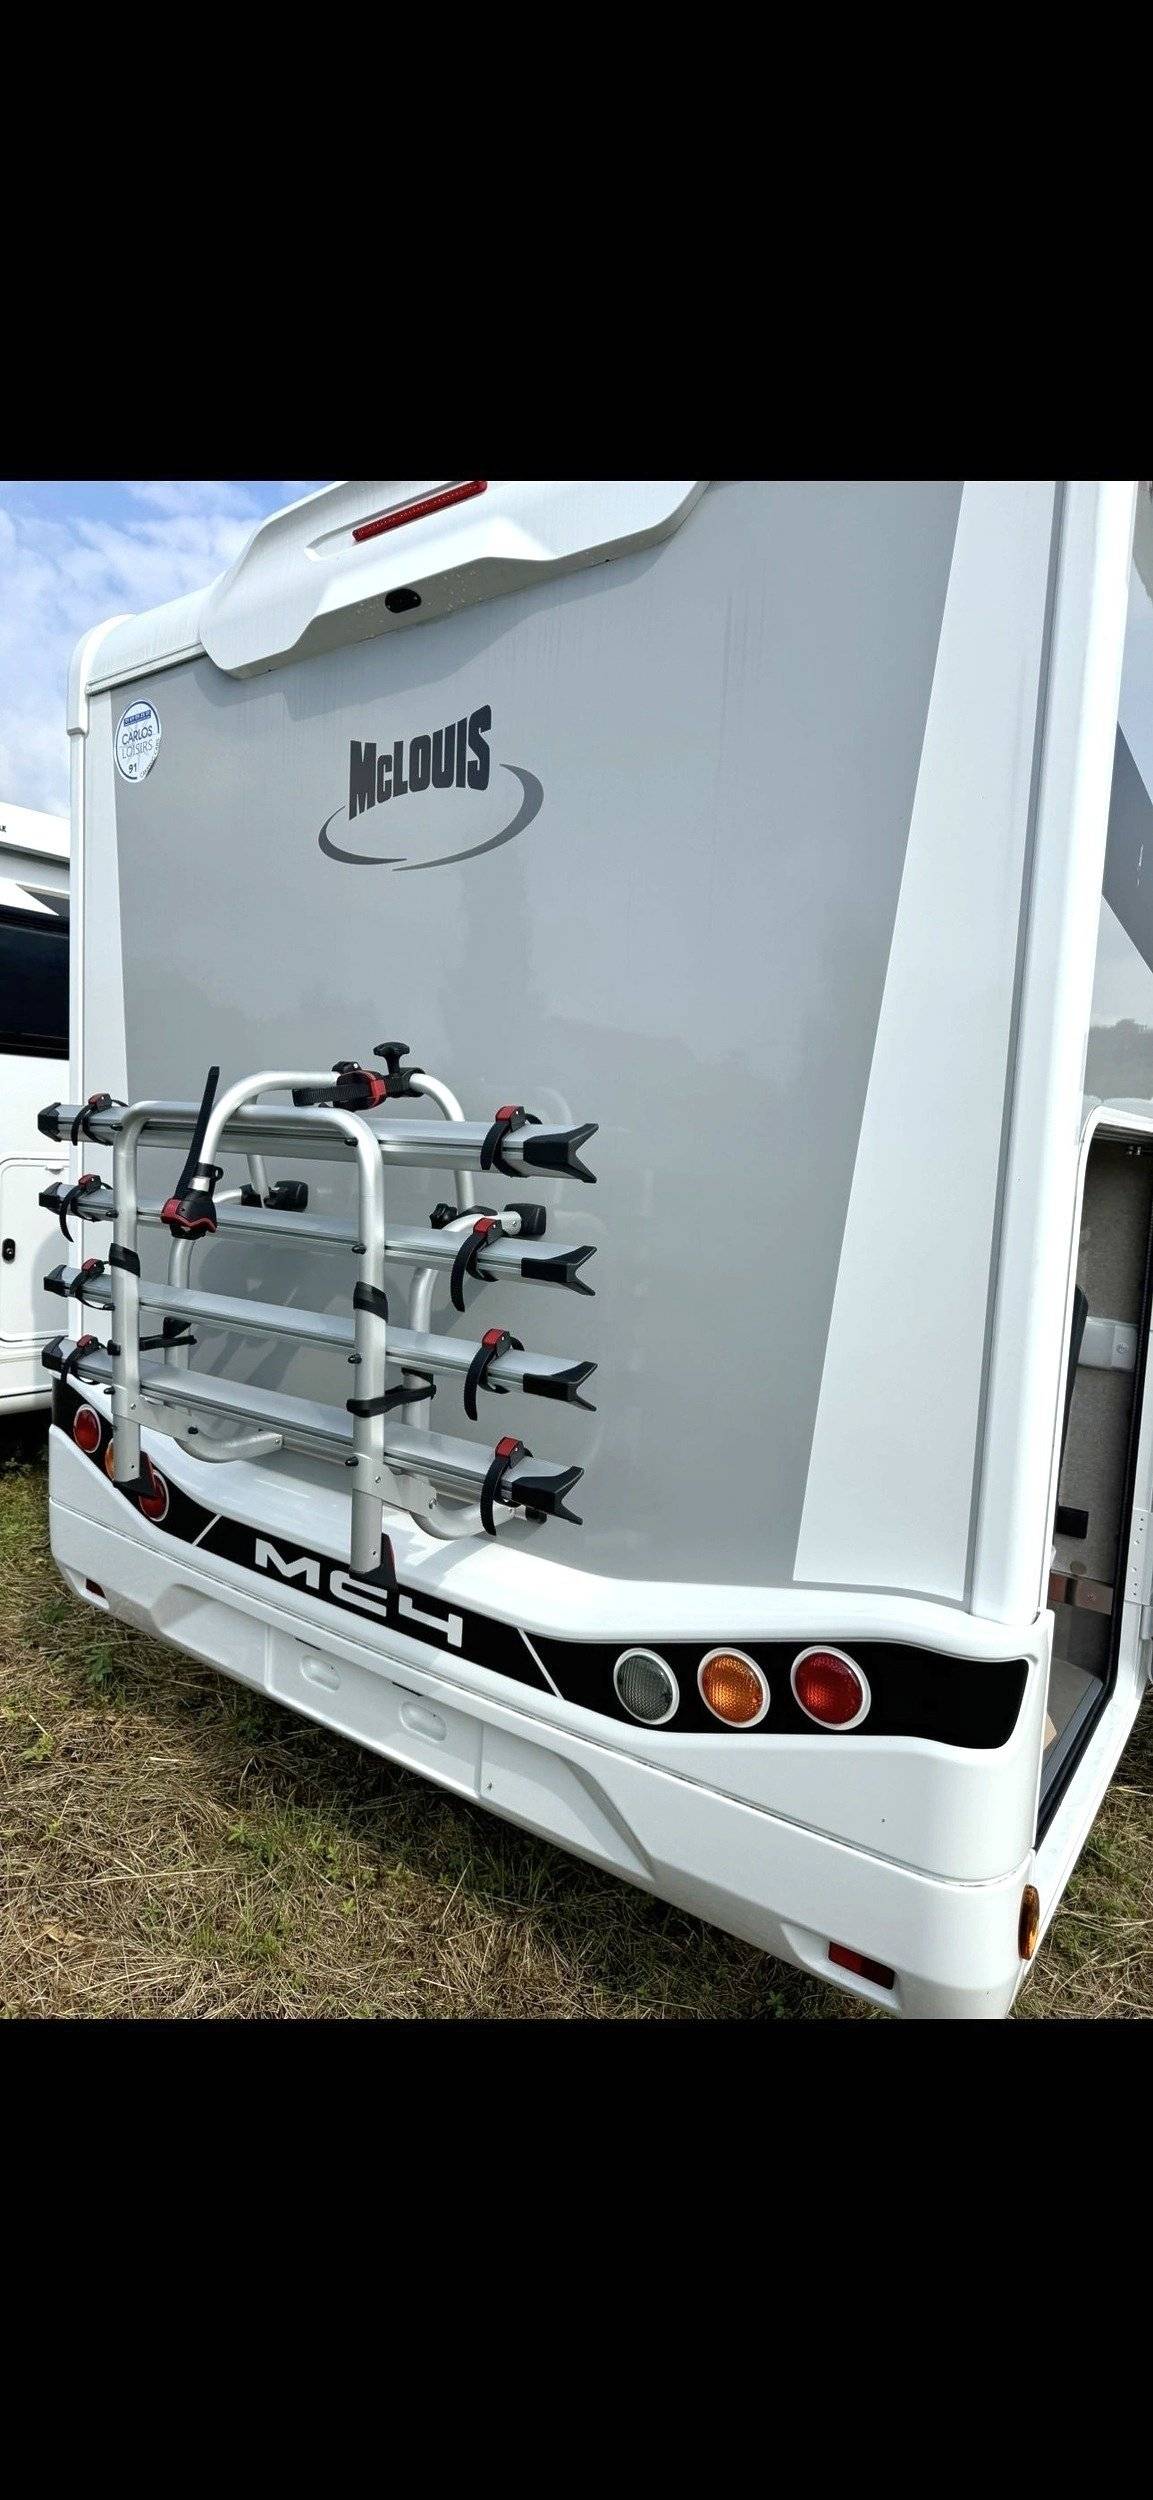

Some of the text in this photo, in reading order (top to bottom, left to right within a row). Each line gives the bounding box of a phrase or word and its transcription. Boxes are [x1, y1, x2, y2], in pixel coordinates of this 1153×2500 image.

[122, 725, 153, 745] CARLOS
[122, 740, 153, 759] LOISIRS
[128, 763, 137, 774] 91
[349, 704, 492, 821] McLOUIS
[255, 1538, 463, 1648] MC4
